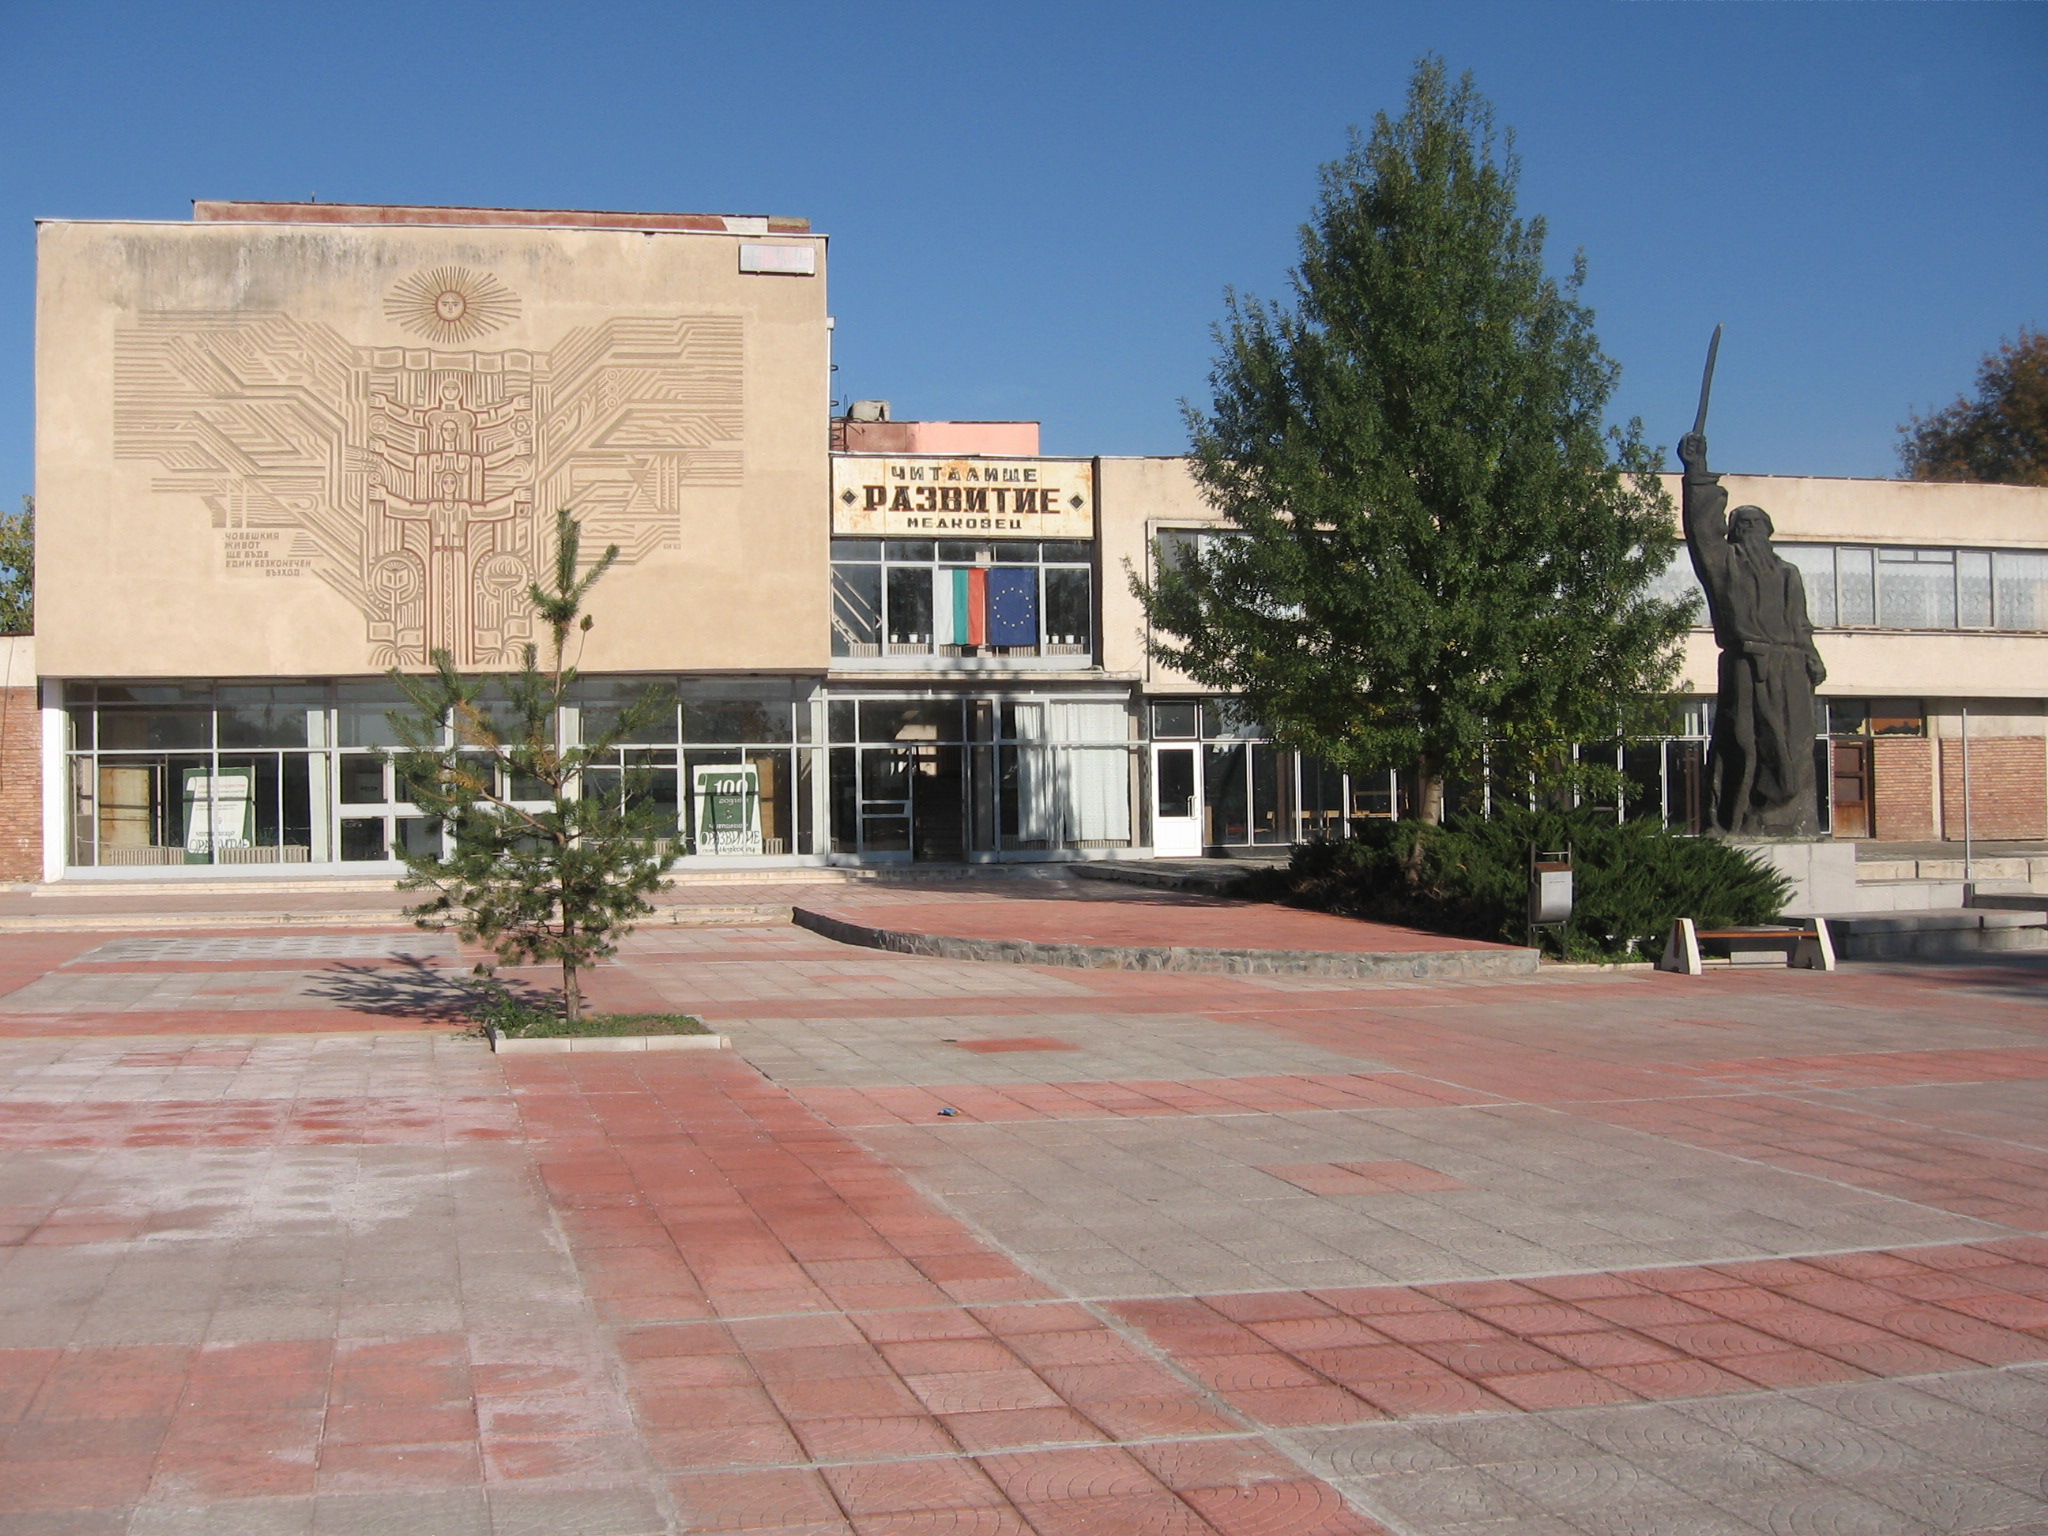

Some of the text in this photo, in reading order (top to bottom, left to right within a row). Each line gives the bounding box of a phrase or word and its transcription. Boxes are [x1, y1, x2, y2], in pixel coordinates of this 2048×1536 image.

[891, 465, 1038, 483] ЧИТАЛИЩЕ
[862, 484, 1061, 514] РАЗВИТИЕ
[907, 517, 1022, 530] МЕДКОВЕЦ
[225, 532, 280, 540] ЧОВЕШКИЯ
[224, 541, 261, 549] ЖИВОТ
[226, 550, 241, 558] ЩЕ
[225, 559, 311, 568] ЕДИН БЕЗКОНЕЧЕН
[713, 779, 749, 795] 100
